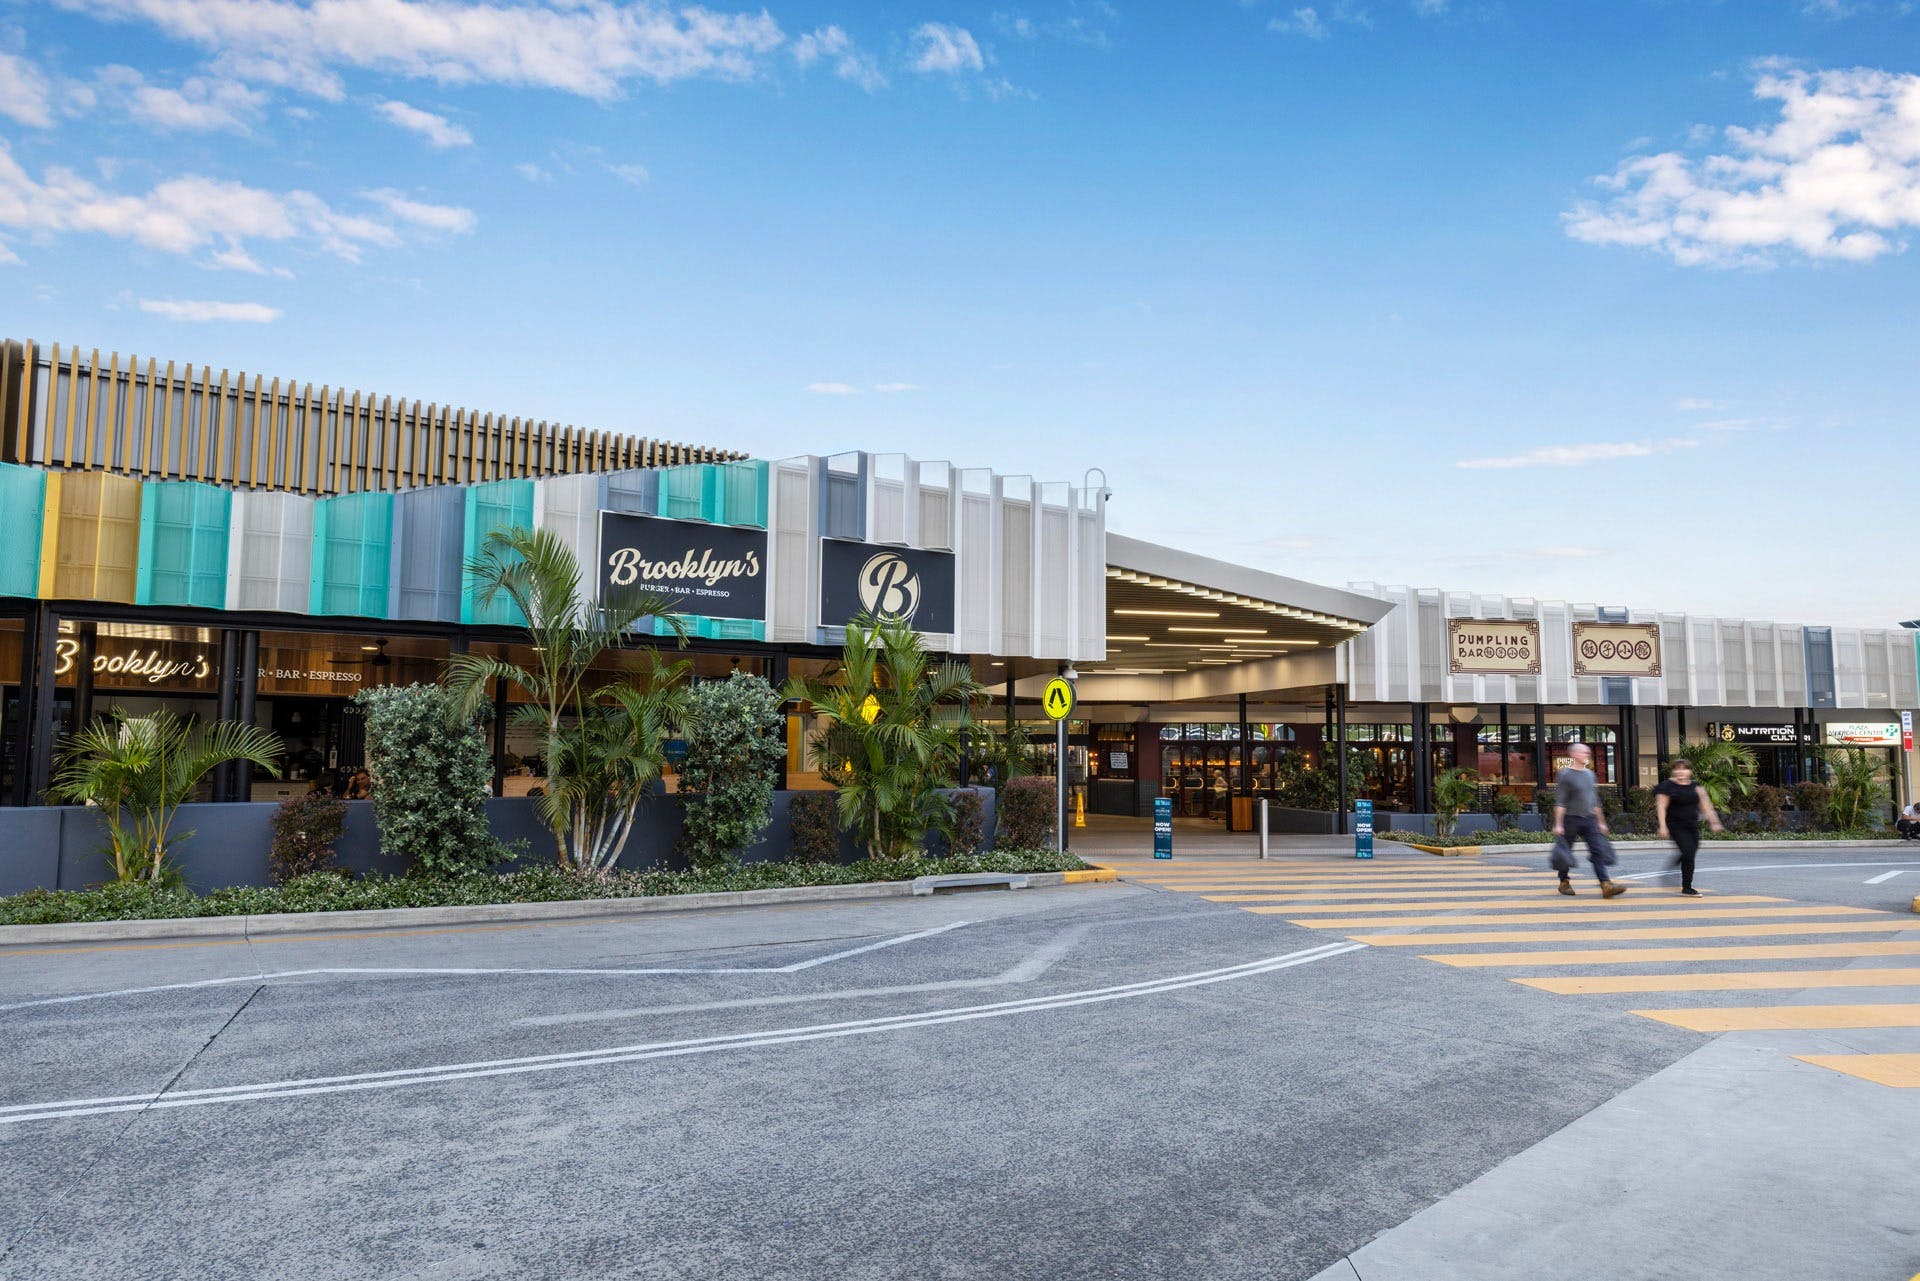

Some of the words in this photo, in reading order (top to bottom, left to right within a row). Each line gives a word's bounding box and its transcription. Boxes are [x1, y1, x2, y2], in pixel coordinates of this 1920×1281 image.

[608, 547, 760, 587] Brooklyn's
[675, 586, 692, 595] BAR
[696, 588, 730, 598] ESPRESSO
[1458, 634, 1529, 646] DUMPLING
[1458, 647, 1484, 658] BAR
[55, 639, 209, 682] Booklyn's
[276, 669, 300, 679] BAR
[309, 670, 362, 682] ESPRESSO
[1738, 727, 1795, 735] NUTRITION
